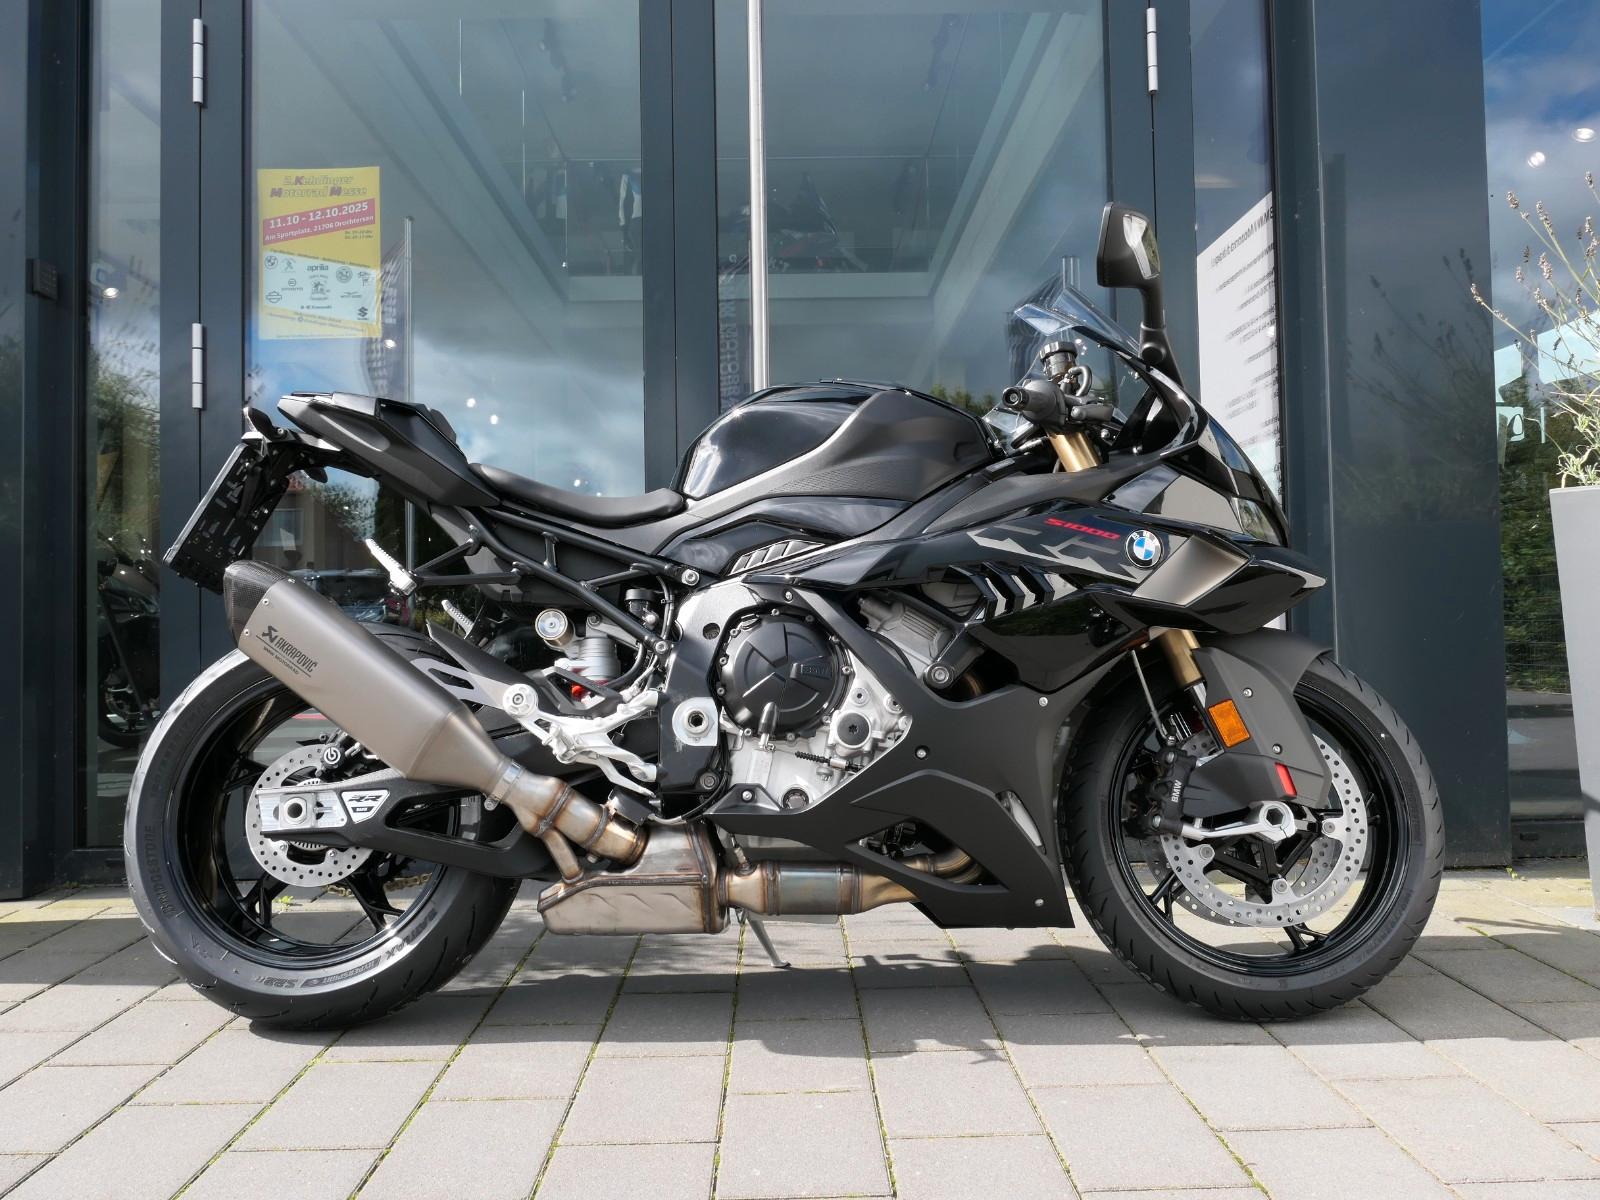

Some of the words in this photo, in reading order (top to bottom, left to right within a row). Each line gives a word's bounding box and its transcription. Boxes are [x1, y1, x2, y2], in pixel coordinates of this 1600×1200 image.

[269, 215, 300, 229] 11.10
[308, 201, 369, 223] 12.10.2025
[306, 263, 329, 272] aprilia
[1043, 517, 1121, 541] S1000
[1171, 779, 1183, 803] BMW
